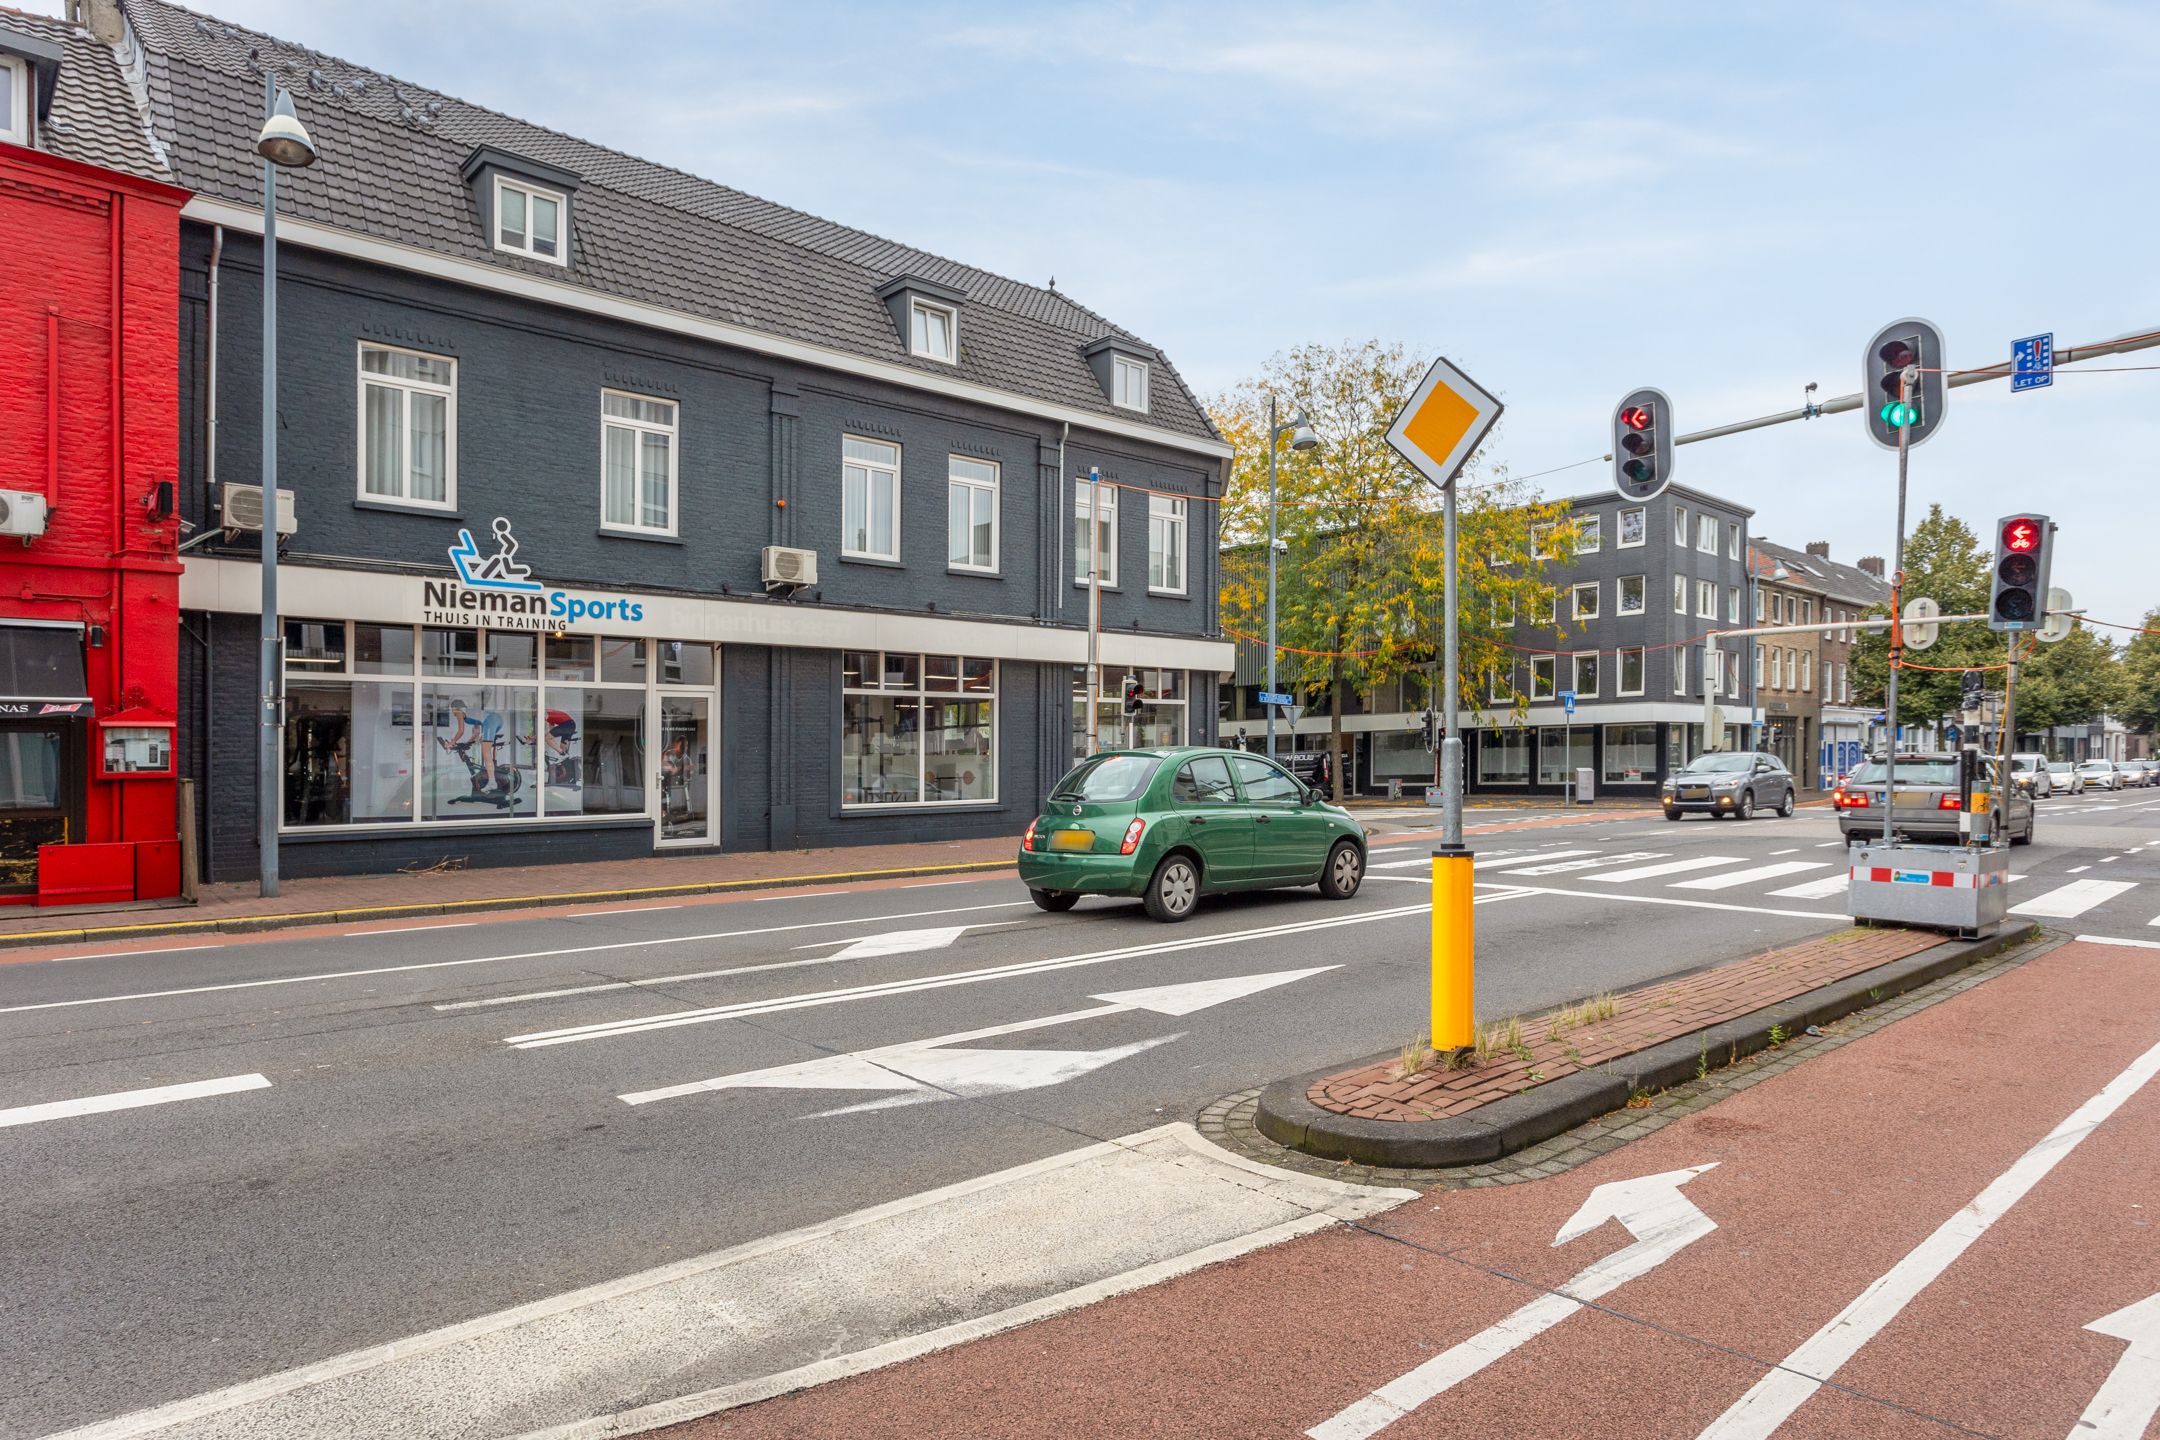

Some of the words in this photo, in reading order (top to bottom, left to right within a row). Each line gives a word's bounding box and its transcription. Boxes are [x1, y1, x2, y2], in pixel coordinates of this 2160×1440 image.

[2015, 377, 2032, 388] LET
[2034, 375, 2049, 384] OP
[424, 611, 469, 625] THUIS
[476, 614, 490, 626] IN
[498, 616, 566, 631] TRAINING
